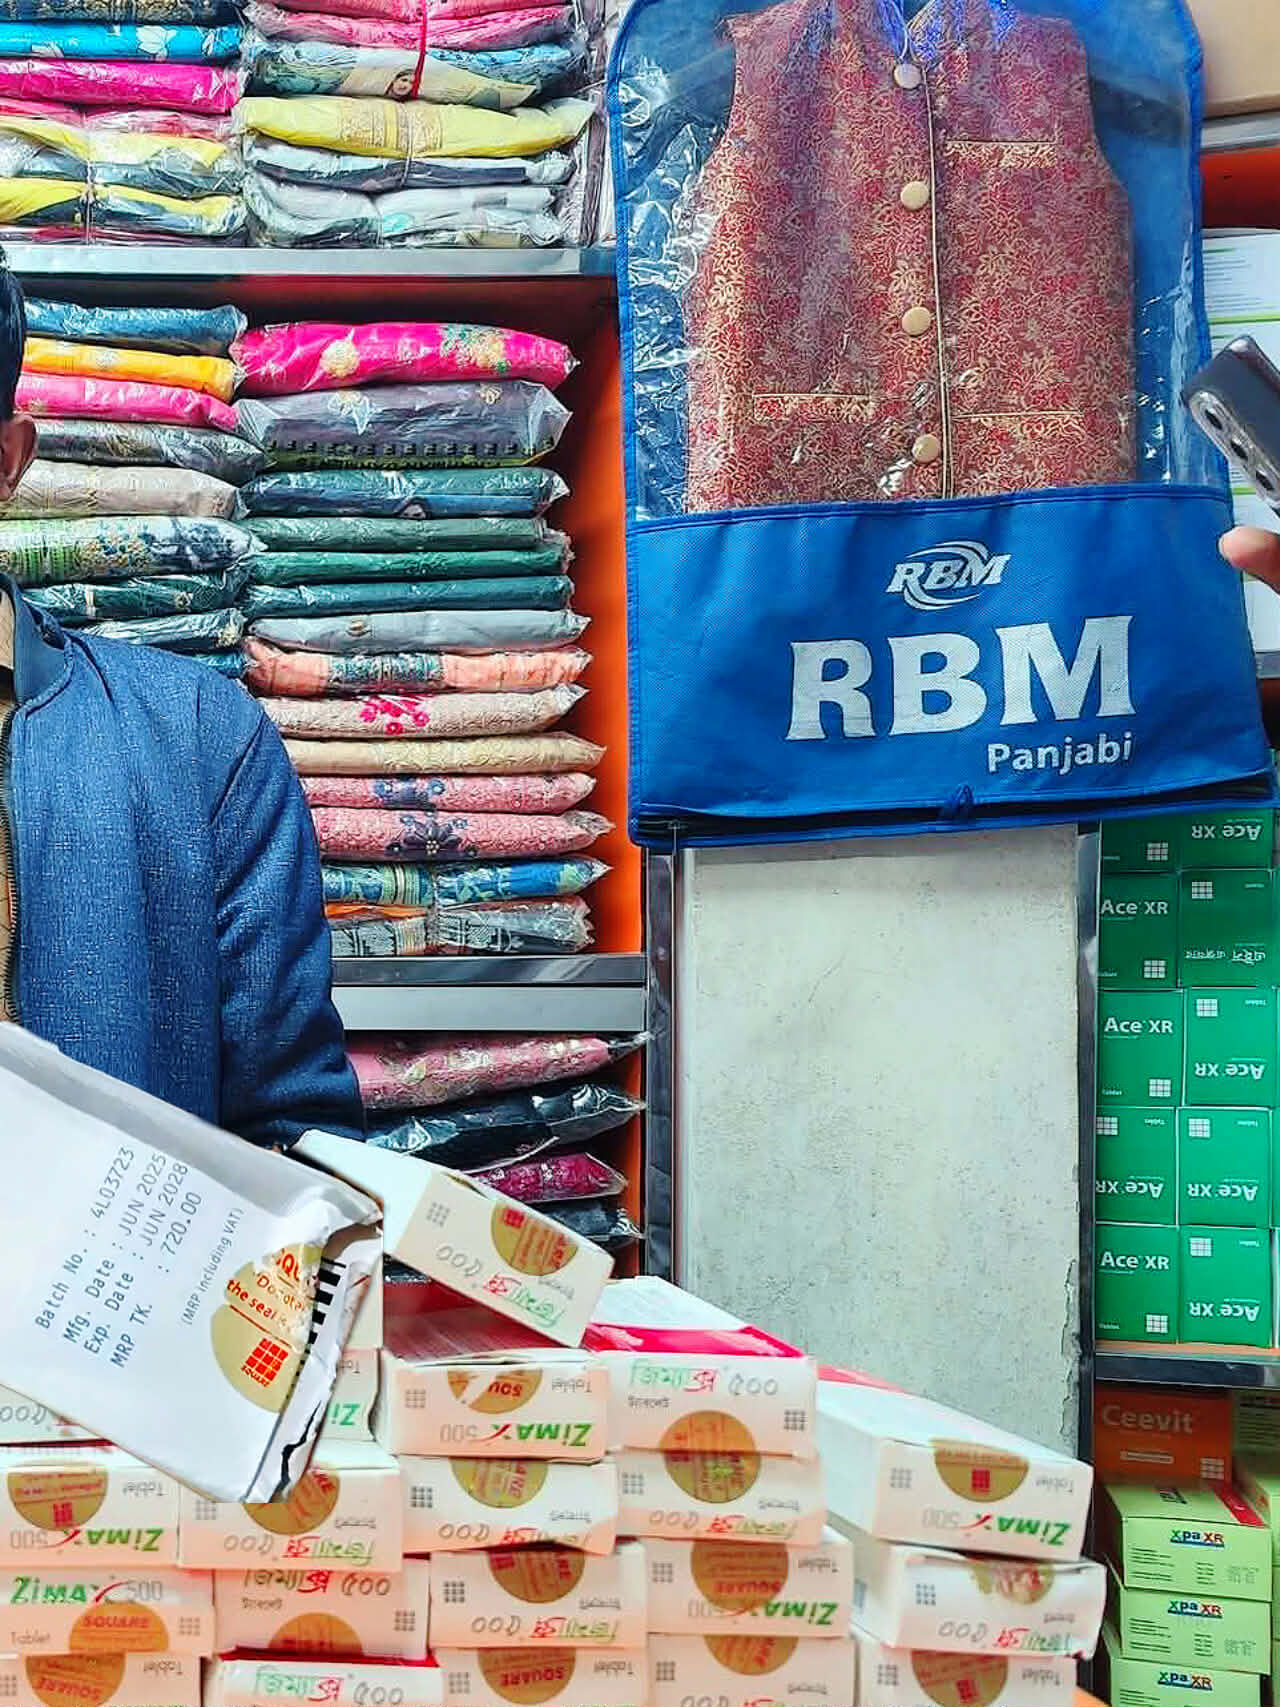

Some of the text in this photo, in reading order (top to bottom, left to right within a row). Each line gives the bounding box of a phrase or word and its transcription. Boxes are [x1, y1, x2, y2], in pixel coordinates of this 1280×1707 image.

[886, 552, 1012, 595] RBM
[786, 615, 1136, 741] RBM
[988, 731, 1132, 776] Panjabi
[1192, 825, 1262, 840] Ace XR
[1100, 900, 1169, 915] Ace XR
[1104, 1017, 1174, 1034] Ace XR
[1195, 1062, 1266, 1080] Ace XR
[1095, 1180, 1164, 1199] Ace XR
[1187, 1183, 1259, 1201] Ace XR
[35, 1280, 69, 1329] Batch
[63, 1248, 88, 1275] No.
[90, 1147, 135, 1219] 4L03723
[63, 1311, 92, 1343] Mfg.
[85, 1259, 114, 1298] Date
[118, 1199, 145, 1236] JUN
[137, 1153, 167, 1195] 2025
[83, 1323, 111, 1354] Exp.
[104, 1272, 134, 1311] Date
[139, 1209, 166, 1246] JUN
[158, 1163, 189, 1206] 2028
[180, 1207, 245, 1325] (MRP including VAT)
[1100, 1251, 1170, 1270] Ace XR
[110, 1333, 136, 1368] MRP
[129, 1304, 153, 1326] TK.
[160, 1191, 202, 1256] 720.00
[227, 1279, 248, 1302] the
[249, 1297, 276, 1320] seal
[1189, 1301, 1260, 1322] Ace XR
[488, 1382, 523, 1397] SQU
[1101, 1404, 1194, 1435] Ceevit
[1203, 1531, 1224, 1545] XR
[127, 1580, 163, 1601] 500
[1201, 1603, 1223, 1617] XR
[500, 1667, 565, 1686] SQUARE
[1191, 1674, 1212, 1688] XR
